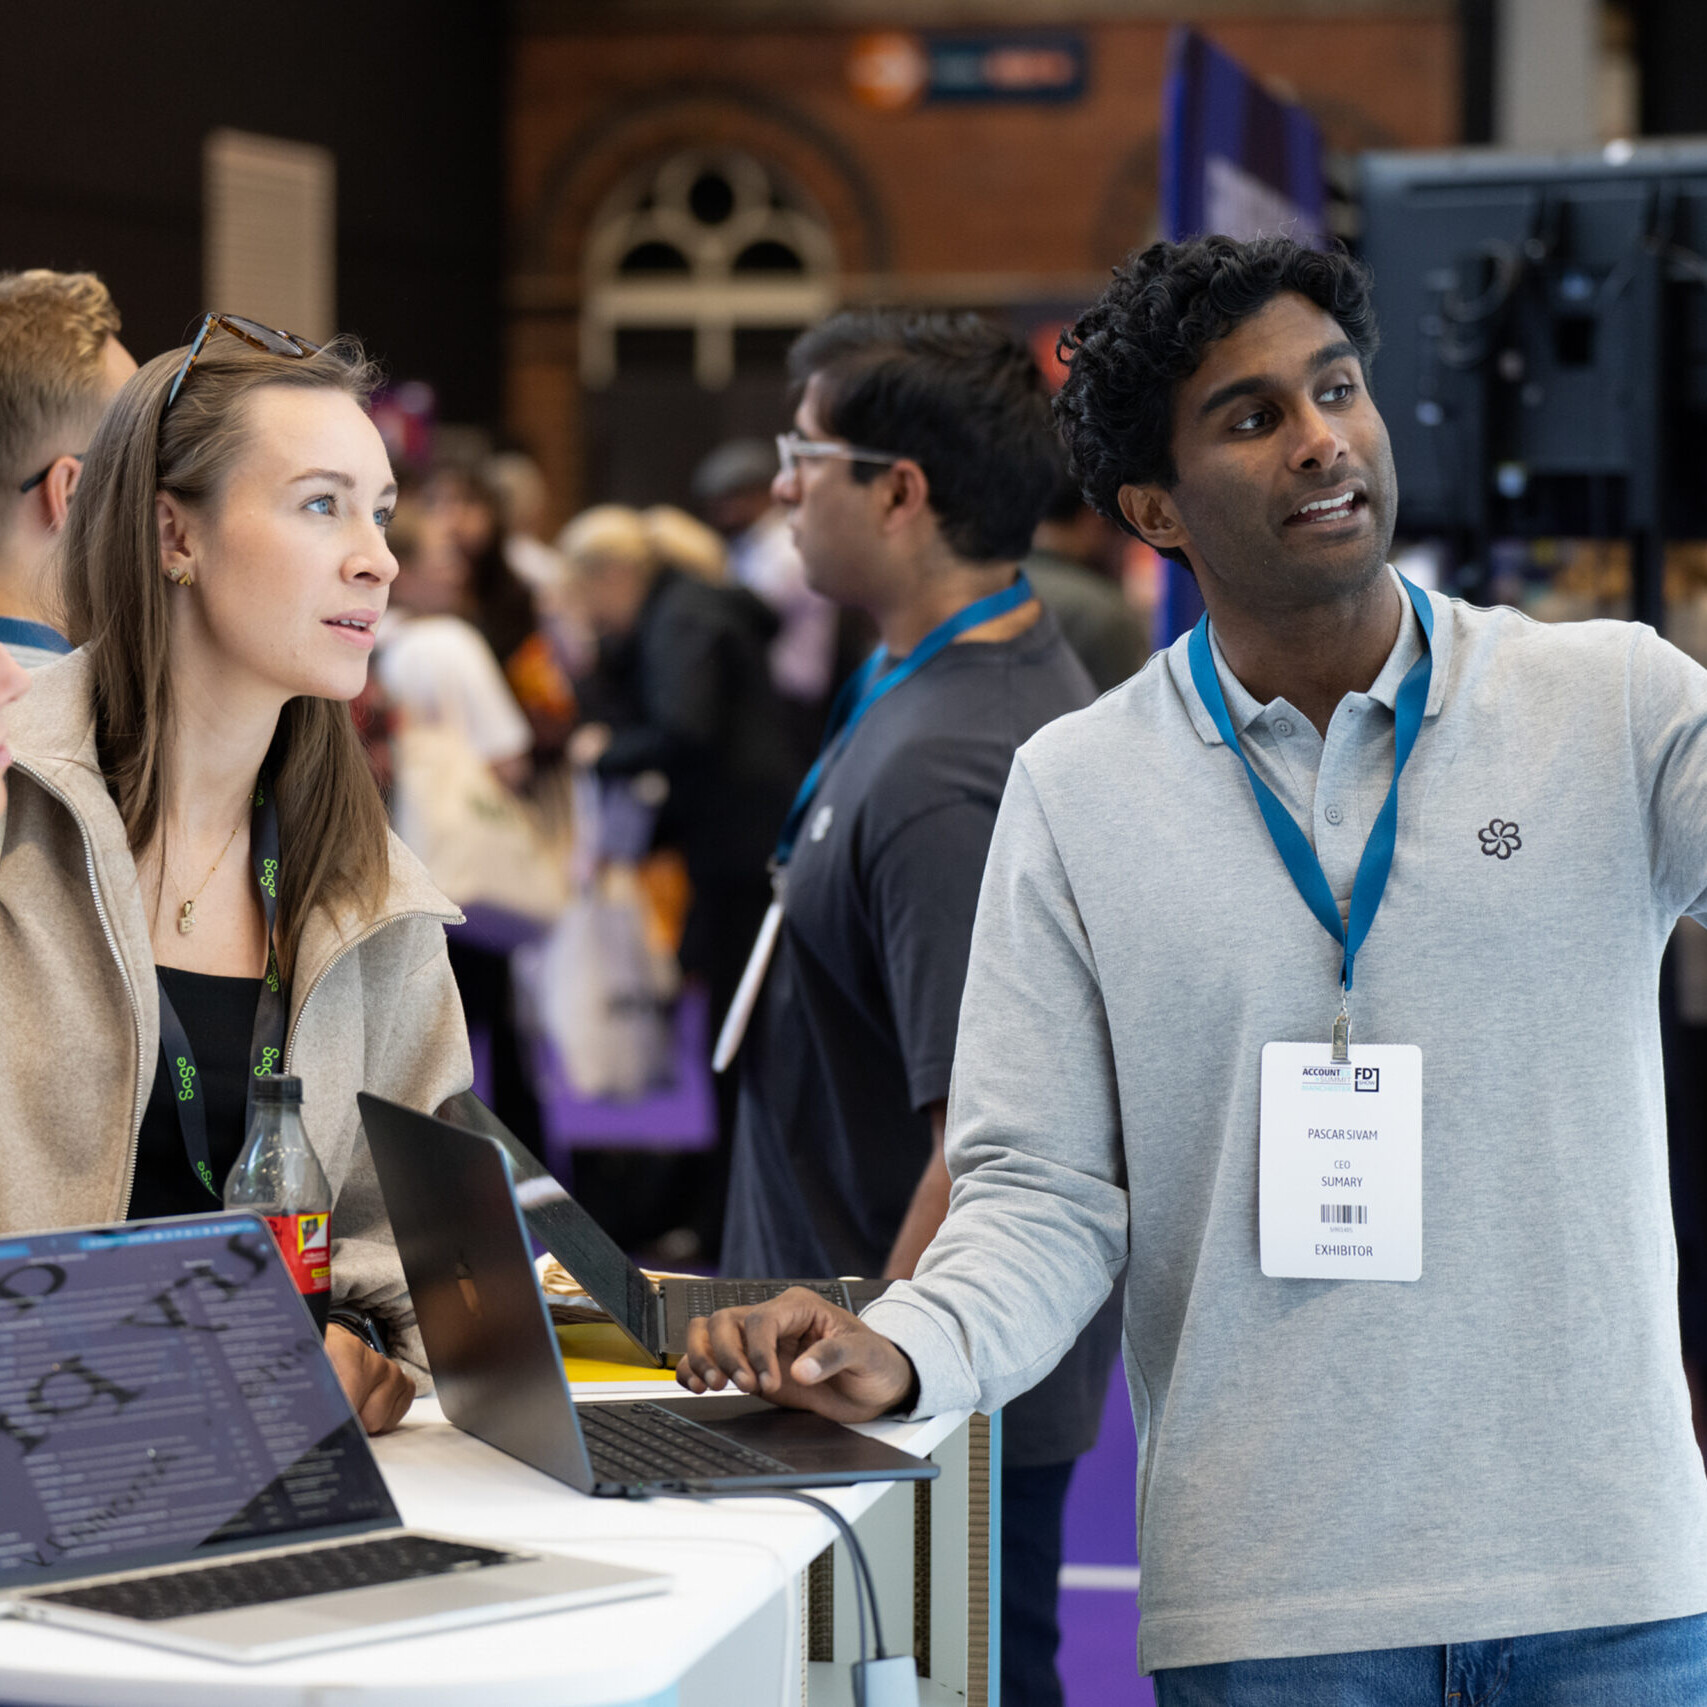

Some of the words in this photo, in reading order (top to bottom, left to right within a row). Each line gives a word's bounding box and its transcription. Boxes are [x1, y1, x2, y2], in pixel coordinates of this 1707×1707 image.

[261, 858, 278, 898] Sage
[253, 1046, 280, 1077] Sag
[176, 1056, 197, 1102] Sage
[1354, 1067, 1374, 1080] FD
[1307, 1128, 1345, 1140] PASCAR
[1346, 1129, 1378, 1141] SIVAM
[1334, 1160, 1351, 1169] CEO
[1321, 1176, 1363, 1188] SUMARY
[1314, 1244, 1374, 1257] EXHIBITOR
